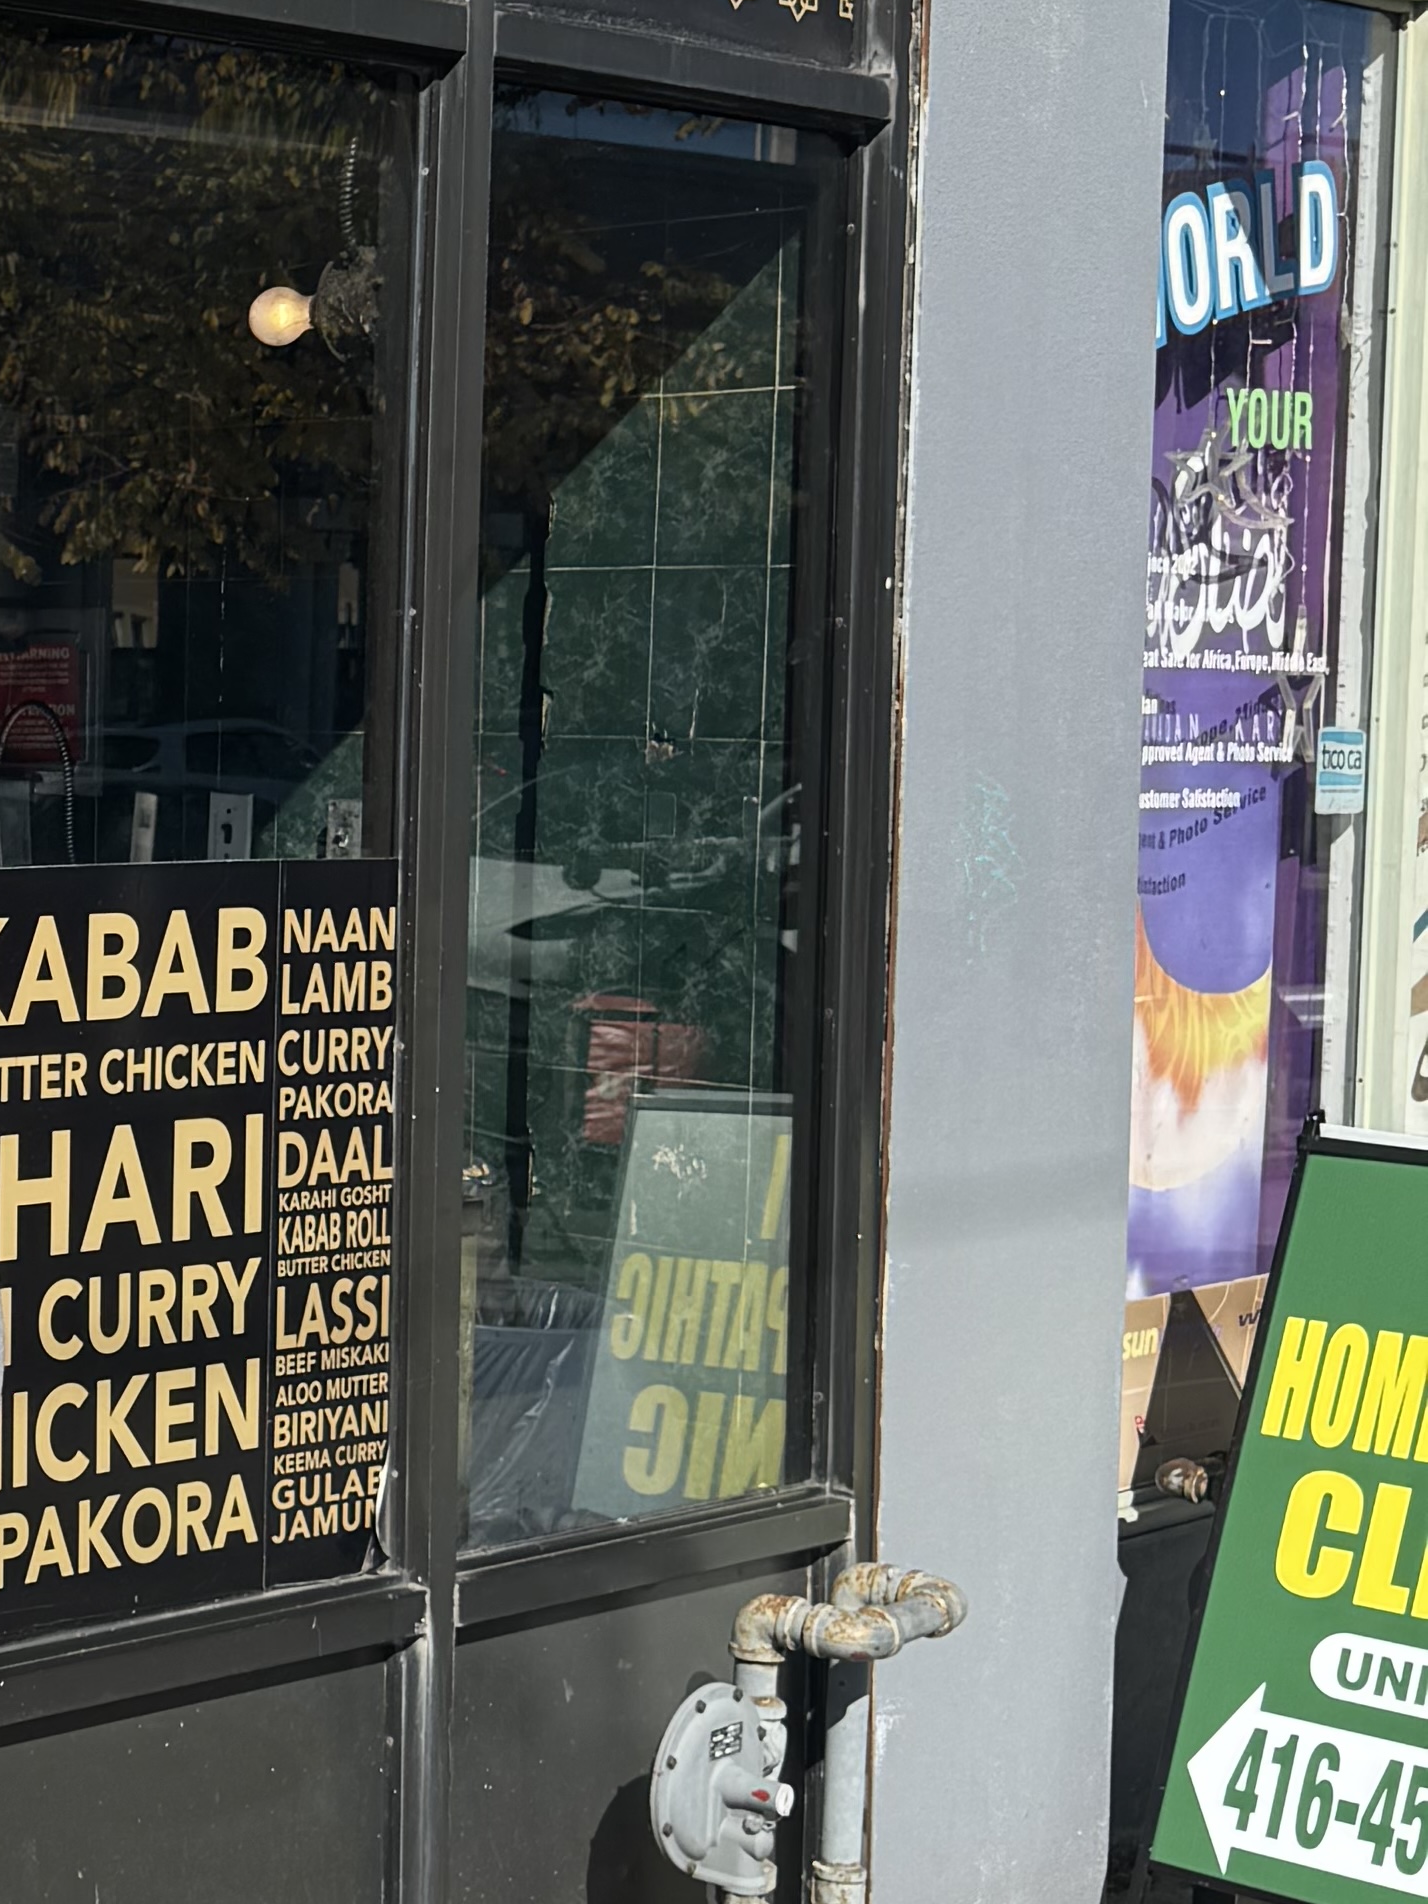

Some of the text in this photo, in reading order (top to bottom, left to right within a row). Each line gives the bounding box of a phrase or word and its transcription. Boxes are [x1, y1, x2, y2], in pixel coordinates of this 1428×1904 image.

[1156, 160, 1339, 348] ORLD
[1227, 387, 1313, 450] YOUR
[1142, 741, 1294, 766] pproved Agent & Photo Service
[1139, 787, 1241, 809] ustomer Satisfaction
[283, 906, 396, 954] NAAN
[281, 960, 393, 1015] LAMB
[99, 1039, 266, 1092] CHICKEN
[277, 1025, 394, 1076] CURRY
[279, 1080, 393, 1121] PAKORA
[277, 1125, 393, 1189] DAAL
[278, 1184, 392, 1213] KARAHI GOSHT
[277, 1207, 392, 1256] KABAB ROLL
[277, 1249, 391, 1278] BUTTER CHICKEN
[38, 1256, 263, 1361] CURRY
[275, 1274, 390, 1350] LASSI
[275, 1342, 390, 1376] BEEF MISKAKI
[275, 1372, 389, 1407] ALOO MUTTER
[1260, 1316, 1428, 1464] HOM
[273, 1399, 389, 1449] BIRIYANI
[273, 1439, 387, 1475] KEEMA CURRY
[1275, 1470, 1428, 1620] CL
